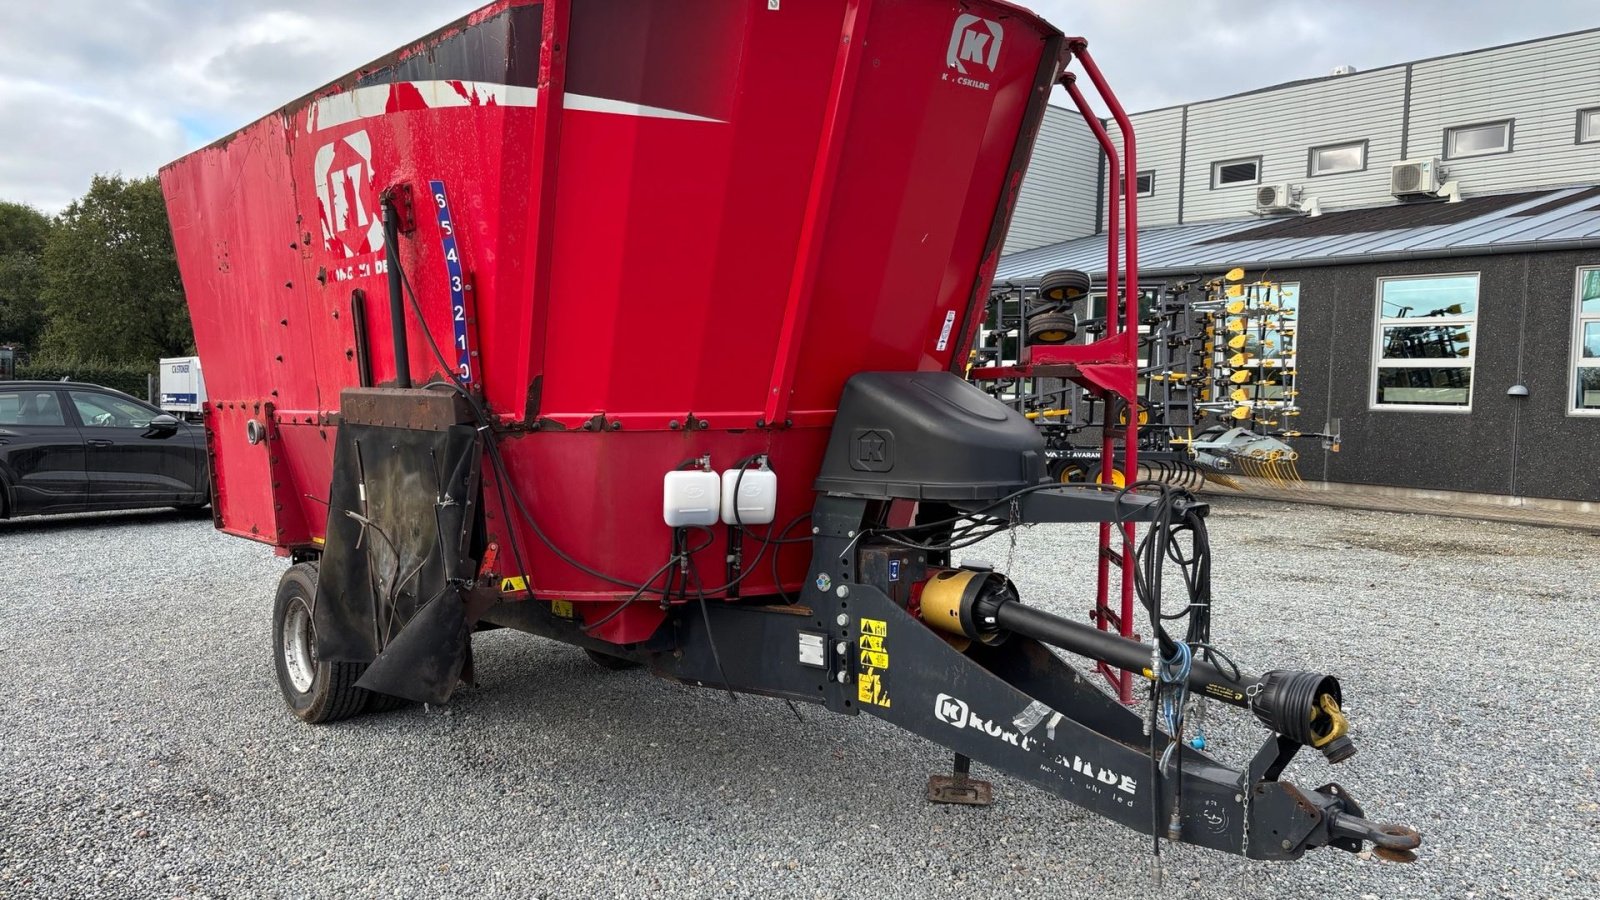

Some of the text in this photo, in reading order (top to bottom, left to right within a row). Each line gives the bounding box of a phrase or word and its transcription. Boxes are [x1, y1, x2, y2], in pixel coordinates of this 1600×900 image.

[960, 29, 991, 65] K
[435, 193, 446, 209] 6
[441, 220, 452, 235] 5
[447, 247, 458, 263] 4
[451, 276, 462, 292] 3
[454, 305, 465, 321] 2
[458, 334, 466, 350] 1
[942, 703, 961, 721] K
